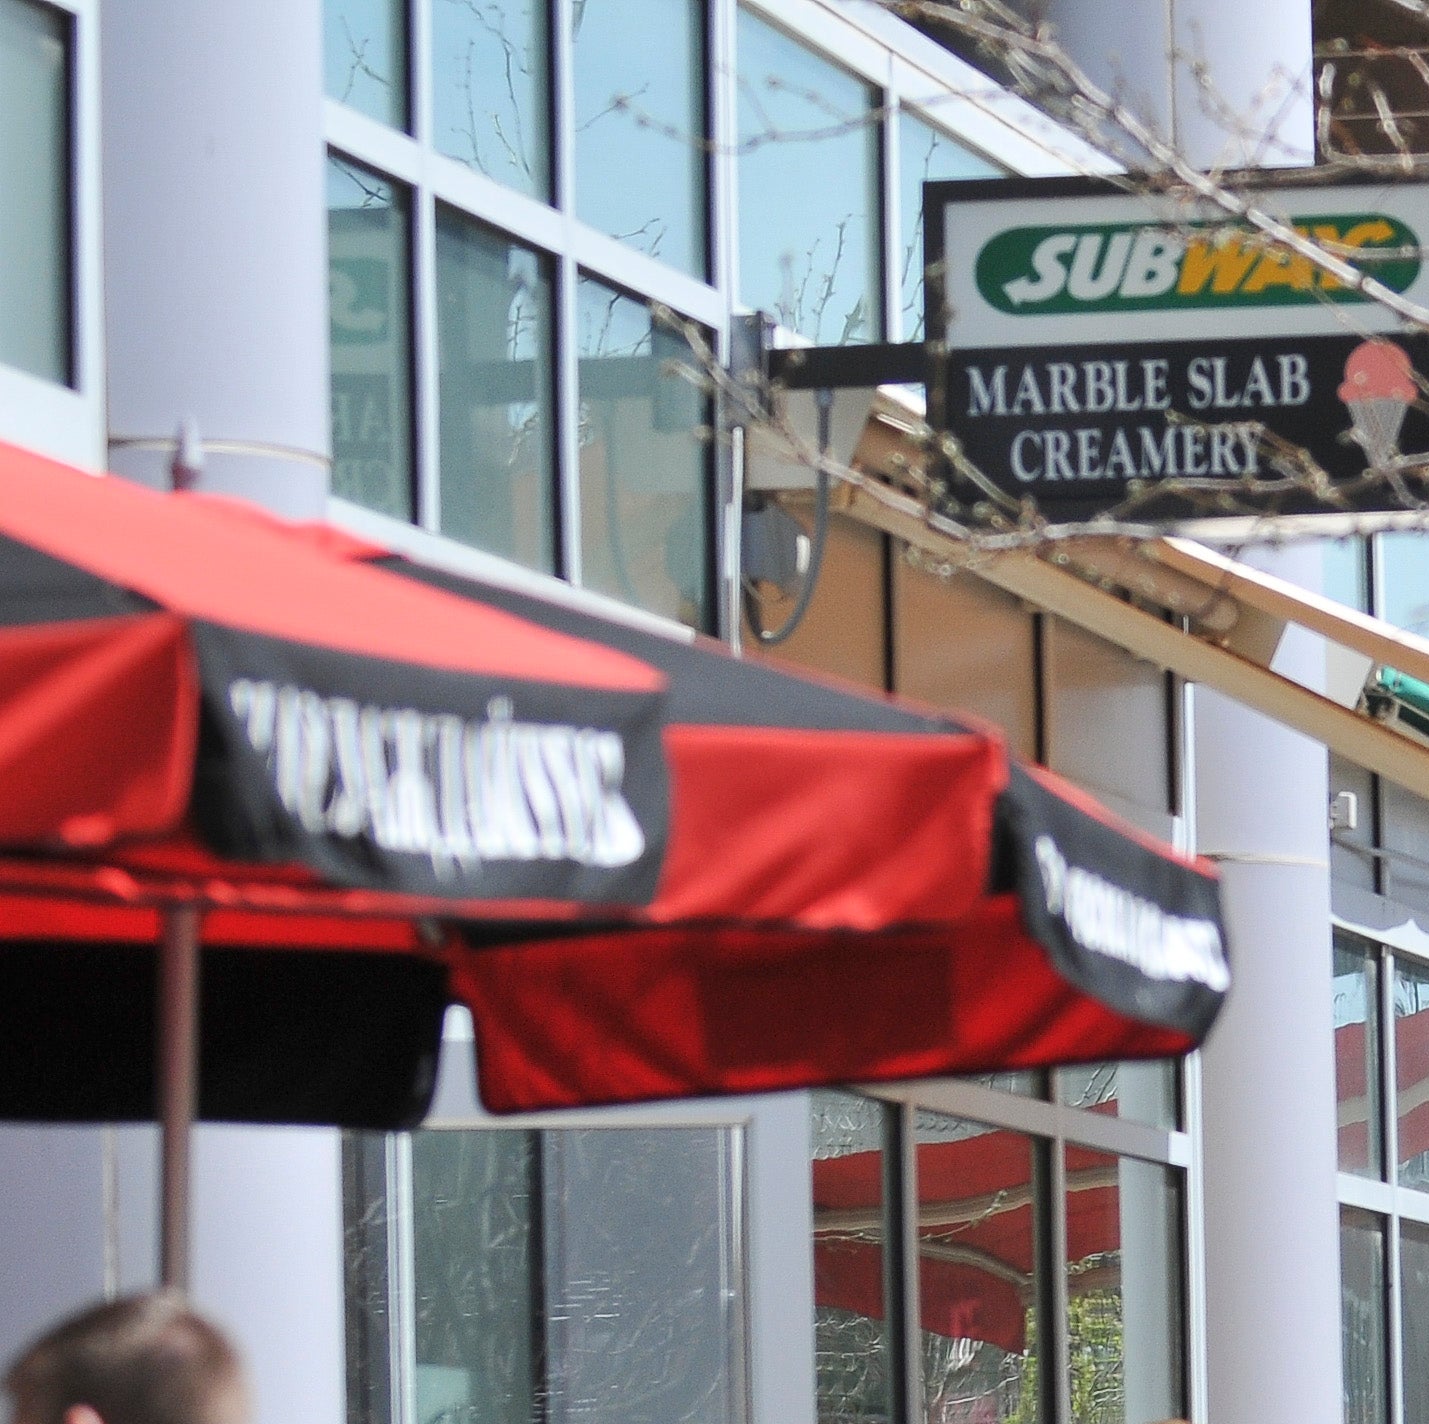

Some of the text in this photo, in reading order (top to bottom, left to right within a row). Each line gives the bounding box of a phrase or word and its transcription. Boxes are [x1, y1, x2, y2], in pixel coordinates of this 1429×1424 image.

[1004, 220, 1396, 304] SUBWAY
[966, 353, 1311, 417] MARBLE SLAB
[1009, 423, 1264, 484] CREAMERY
